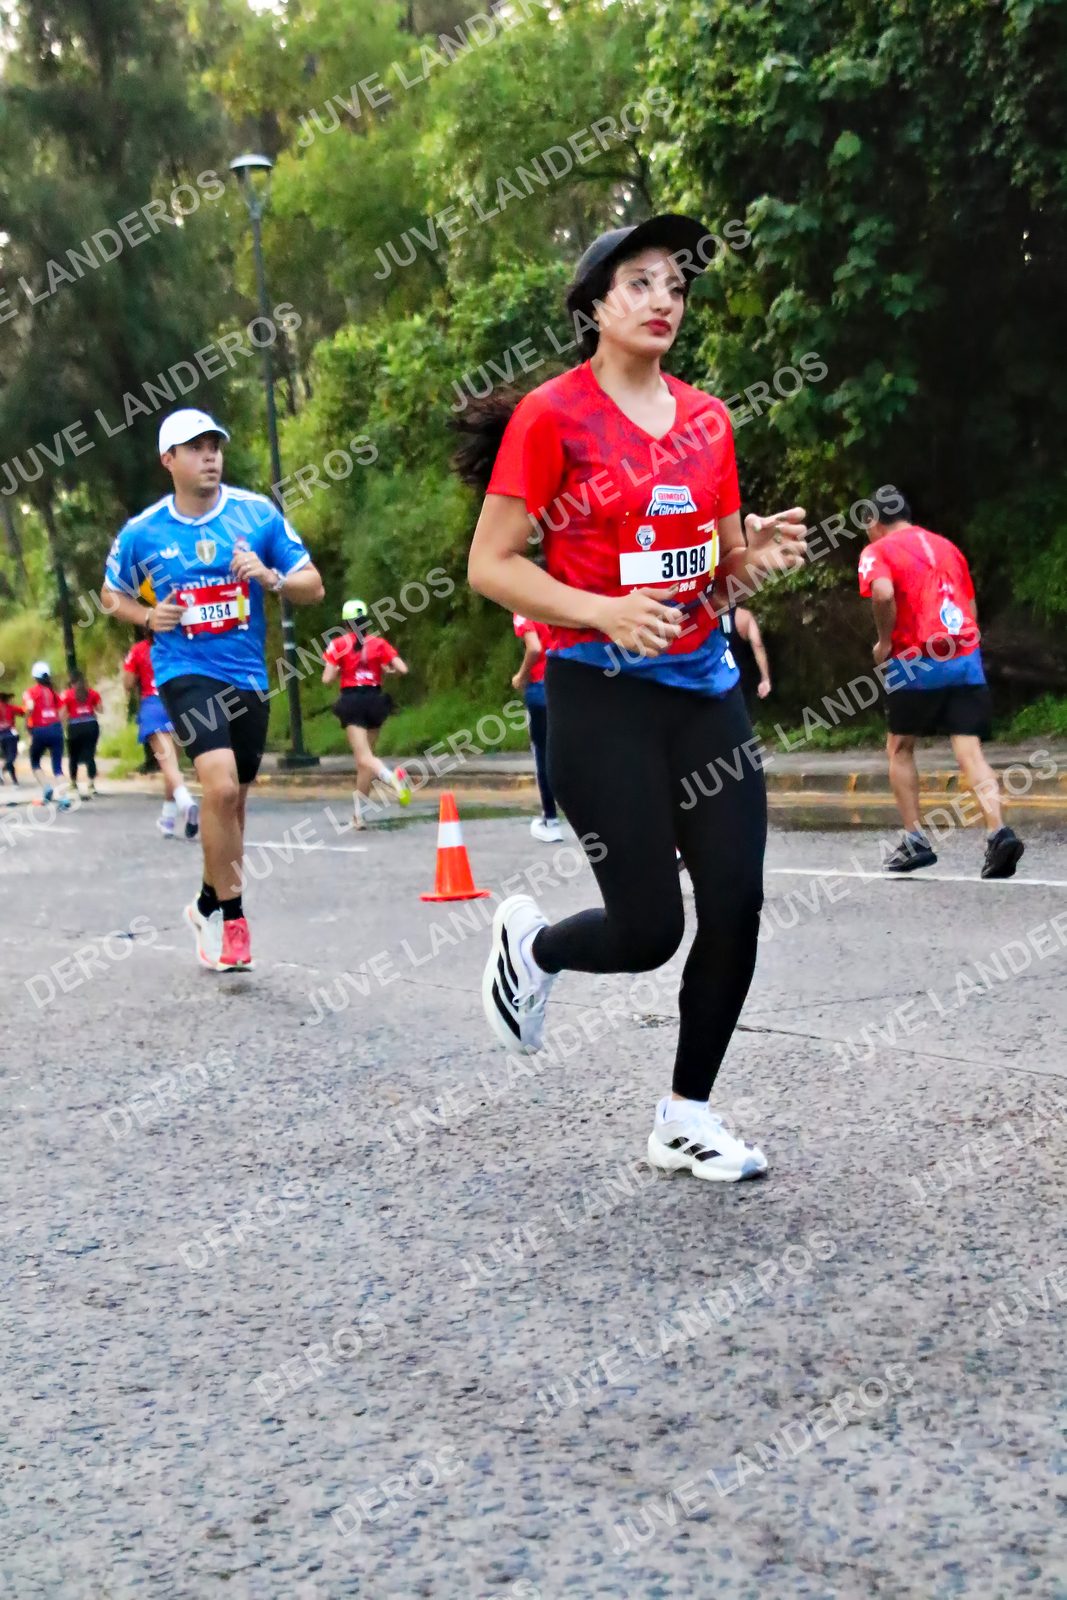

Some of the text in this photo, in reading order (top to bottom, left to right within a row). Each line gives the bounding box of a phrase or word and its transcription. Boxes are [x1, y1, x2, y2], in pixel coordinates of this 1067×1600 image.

[658, 492, 686, 501] BIMBO
[661, 545, 706, 579] 3098
[199, 603, 231, 621] 3254
